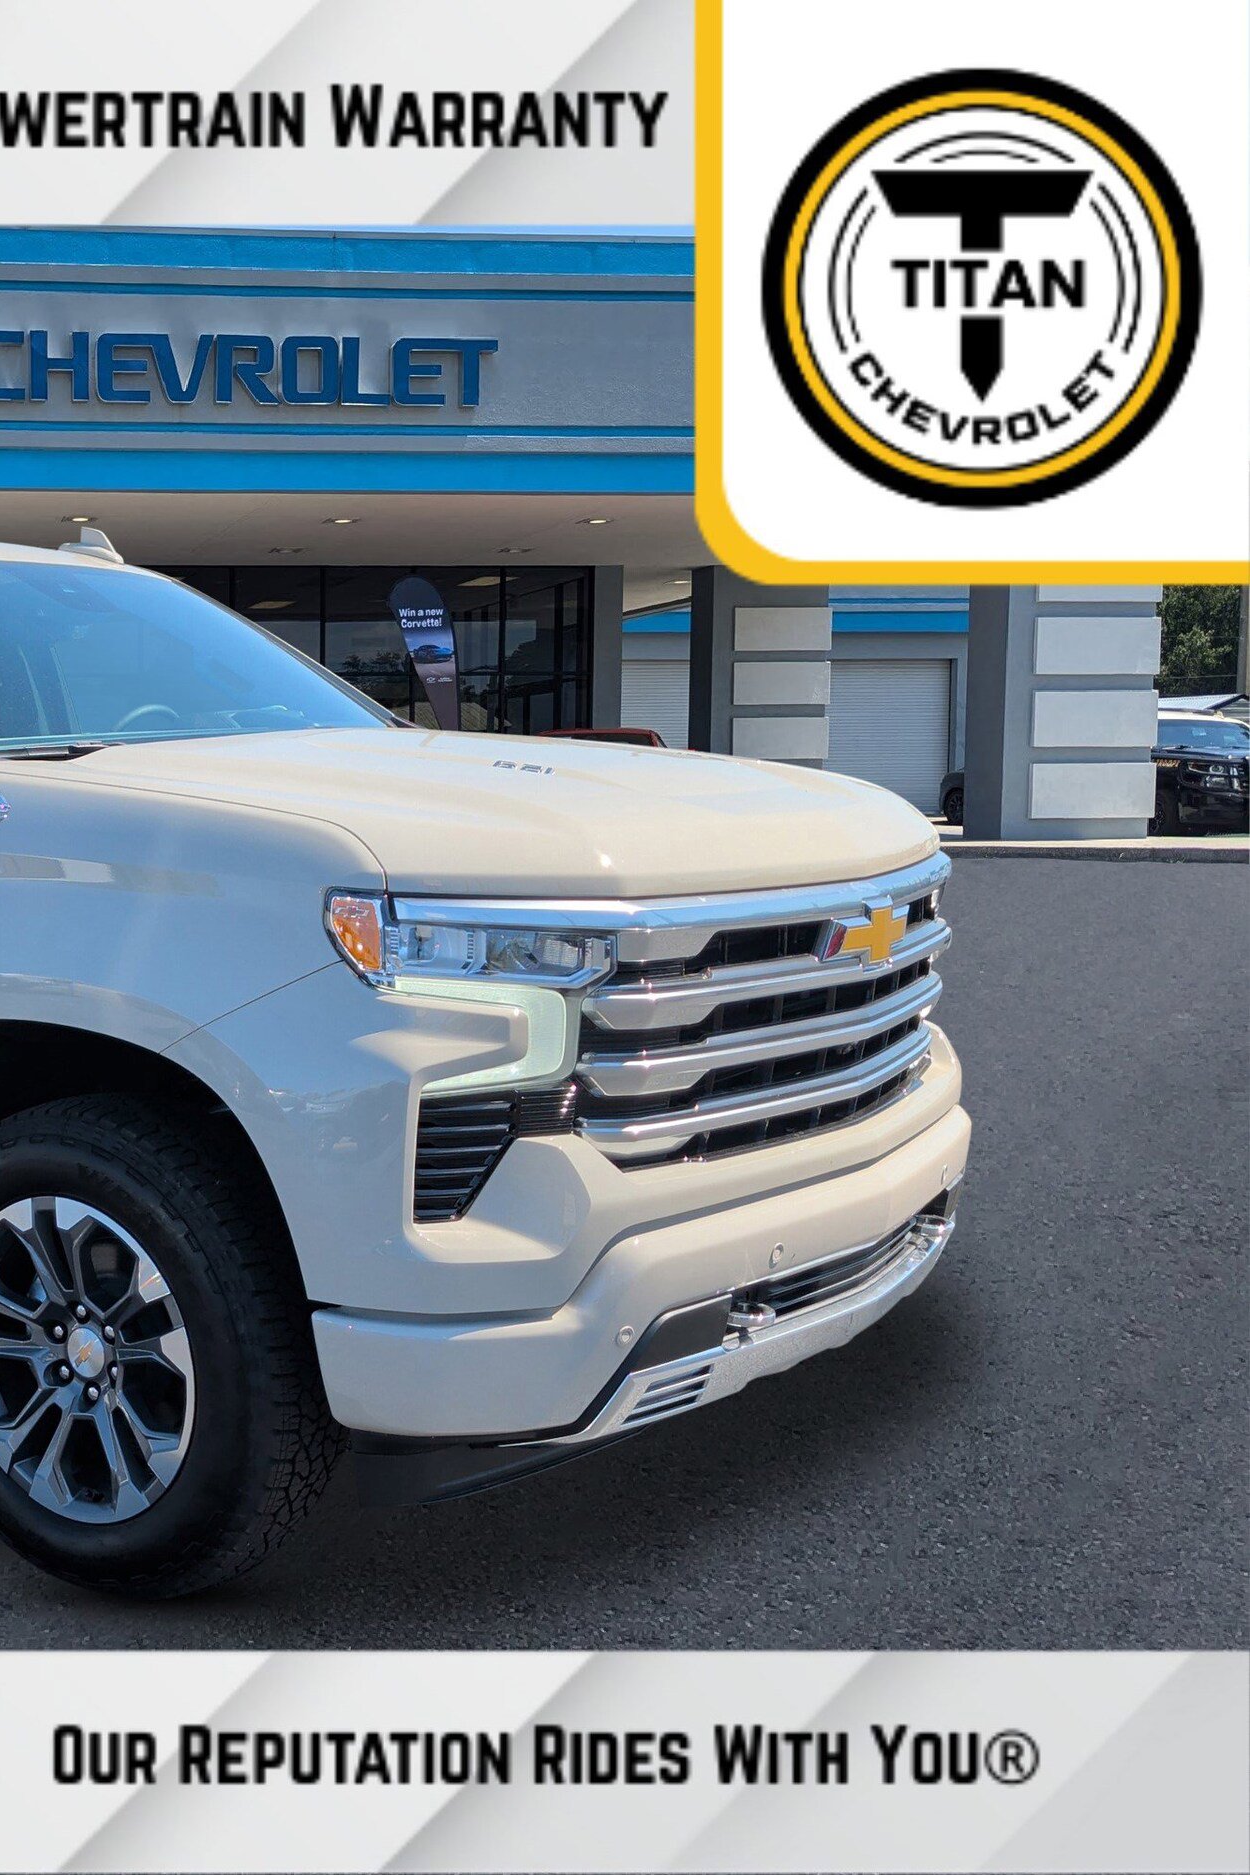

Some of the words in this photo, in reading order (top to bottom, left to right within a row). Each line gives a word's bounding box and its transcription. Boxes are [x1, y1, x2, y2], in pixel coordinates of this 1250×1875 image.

[399, 608, 416, 617] Win
[417, 609, 424, 617] a
[425, 608, 443, 616] new
[400, 617, 442, 628] Corvette!
